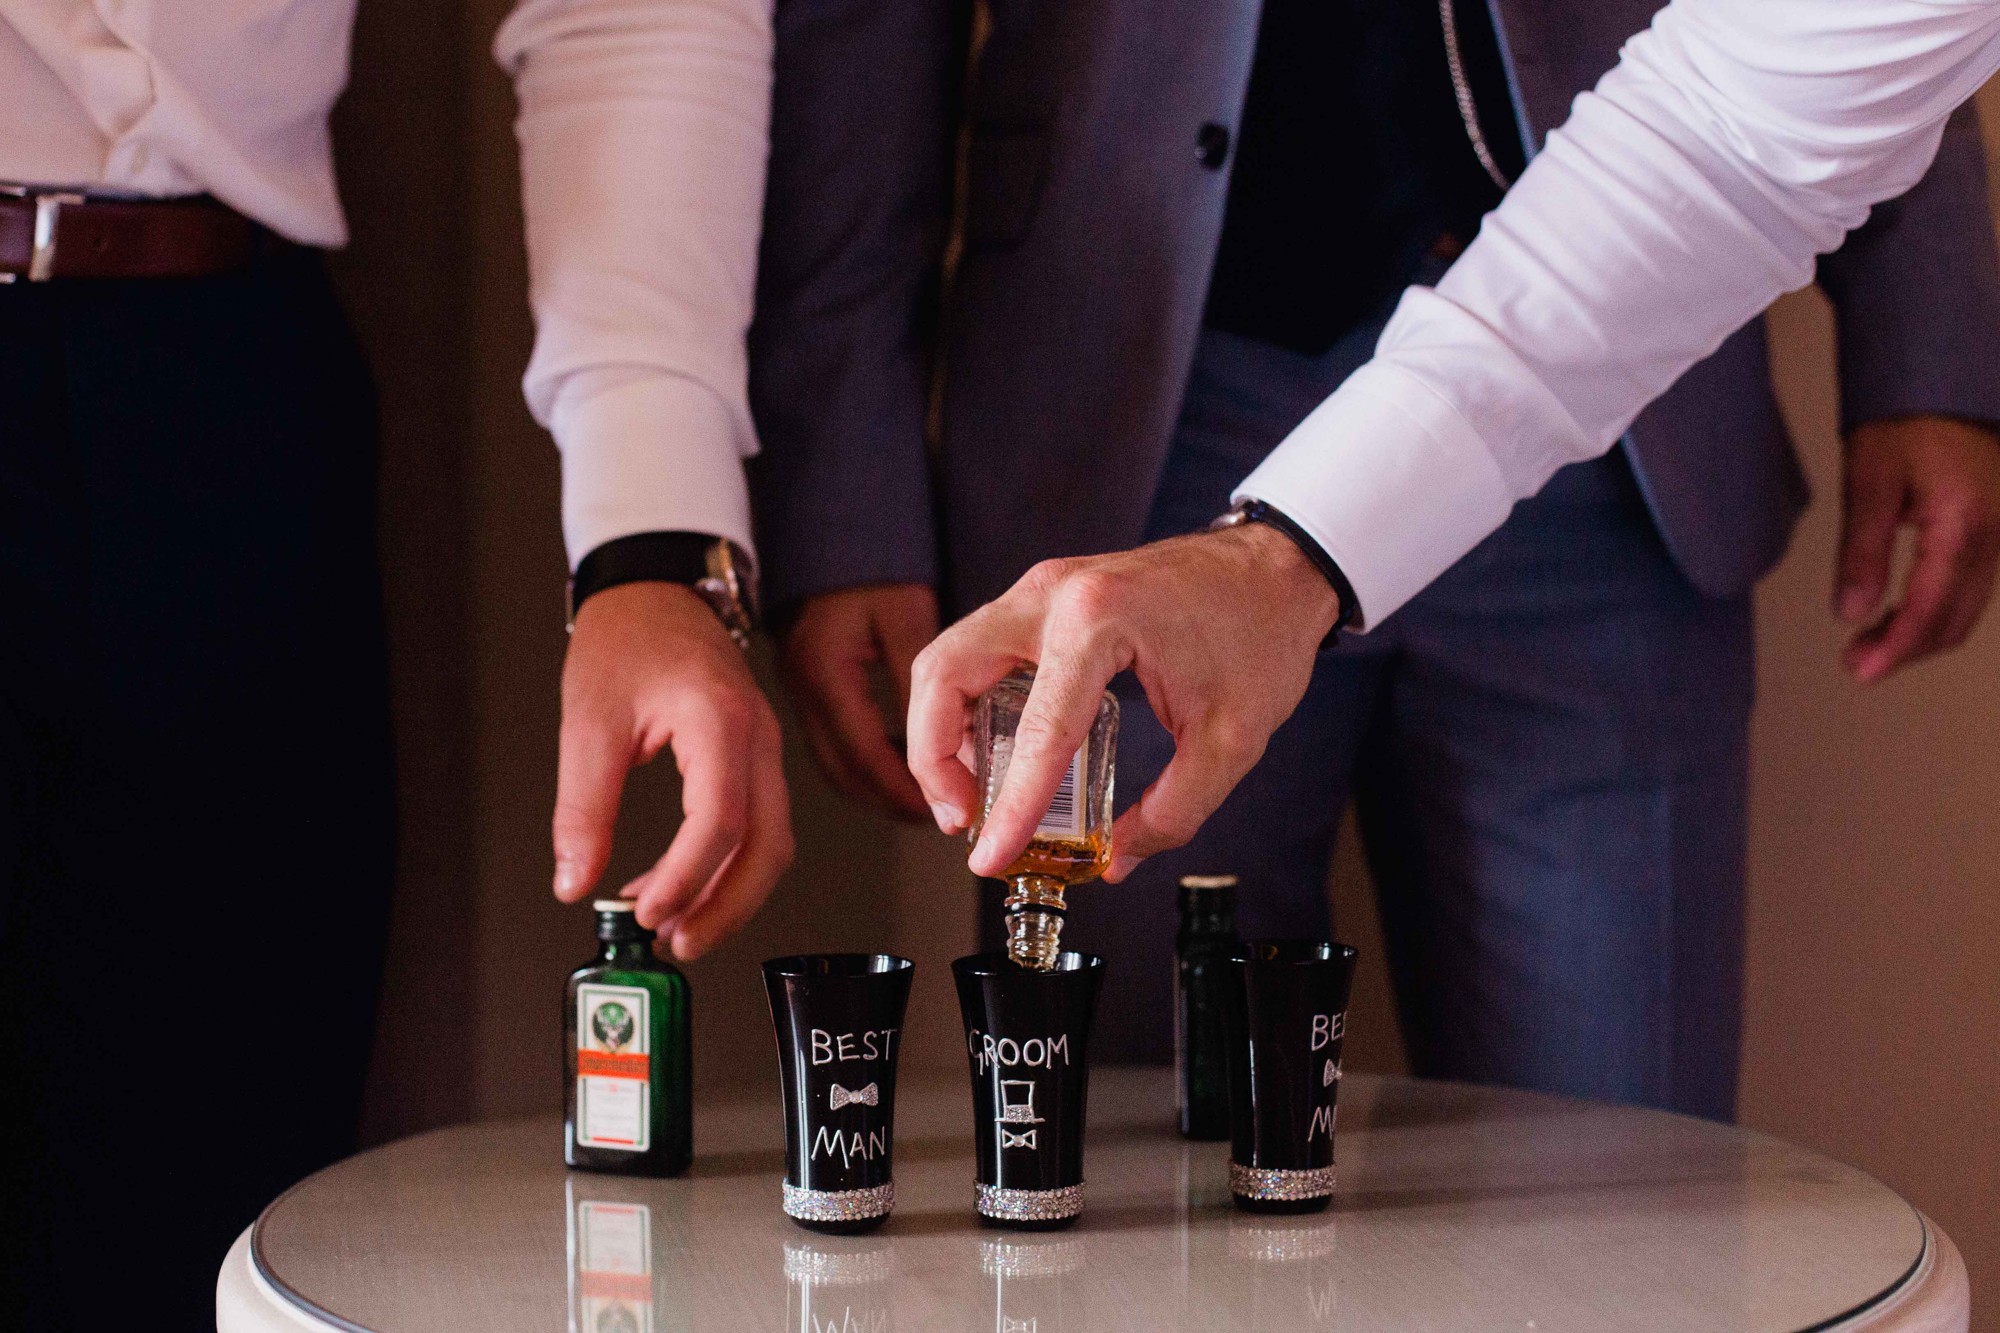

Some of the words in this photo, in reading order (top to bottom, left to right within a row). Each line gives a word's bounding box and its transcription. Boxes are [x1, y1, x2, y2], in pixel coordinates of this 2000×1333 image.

[811, 1028, 898, 1065] BEST
[968, 1028, 1069, 1076] GROOM
[810, 1125, 886, 1169] MAN
